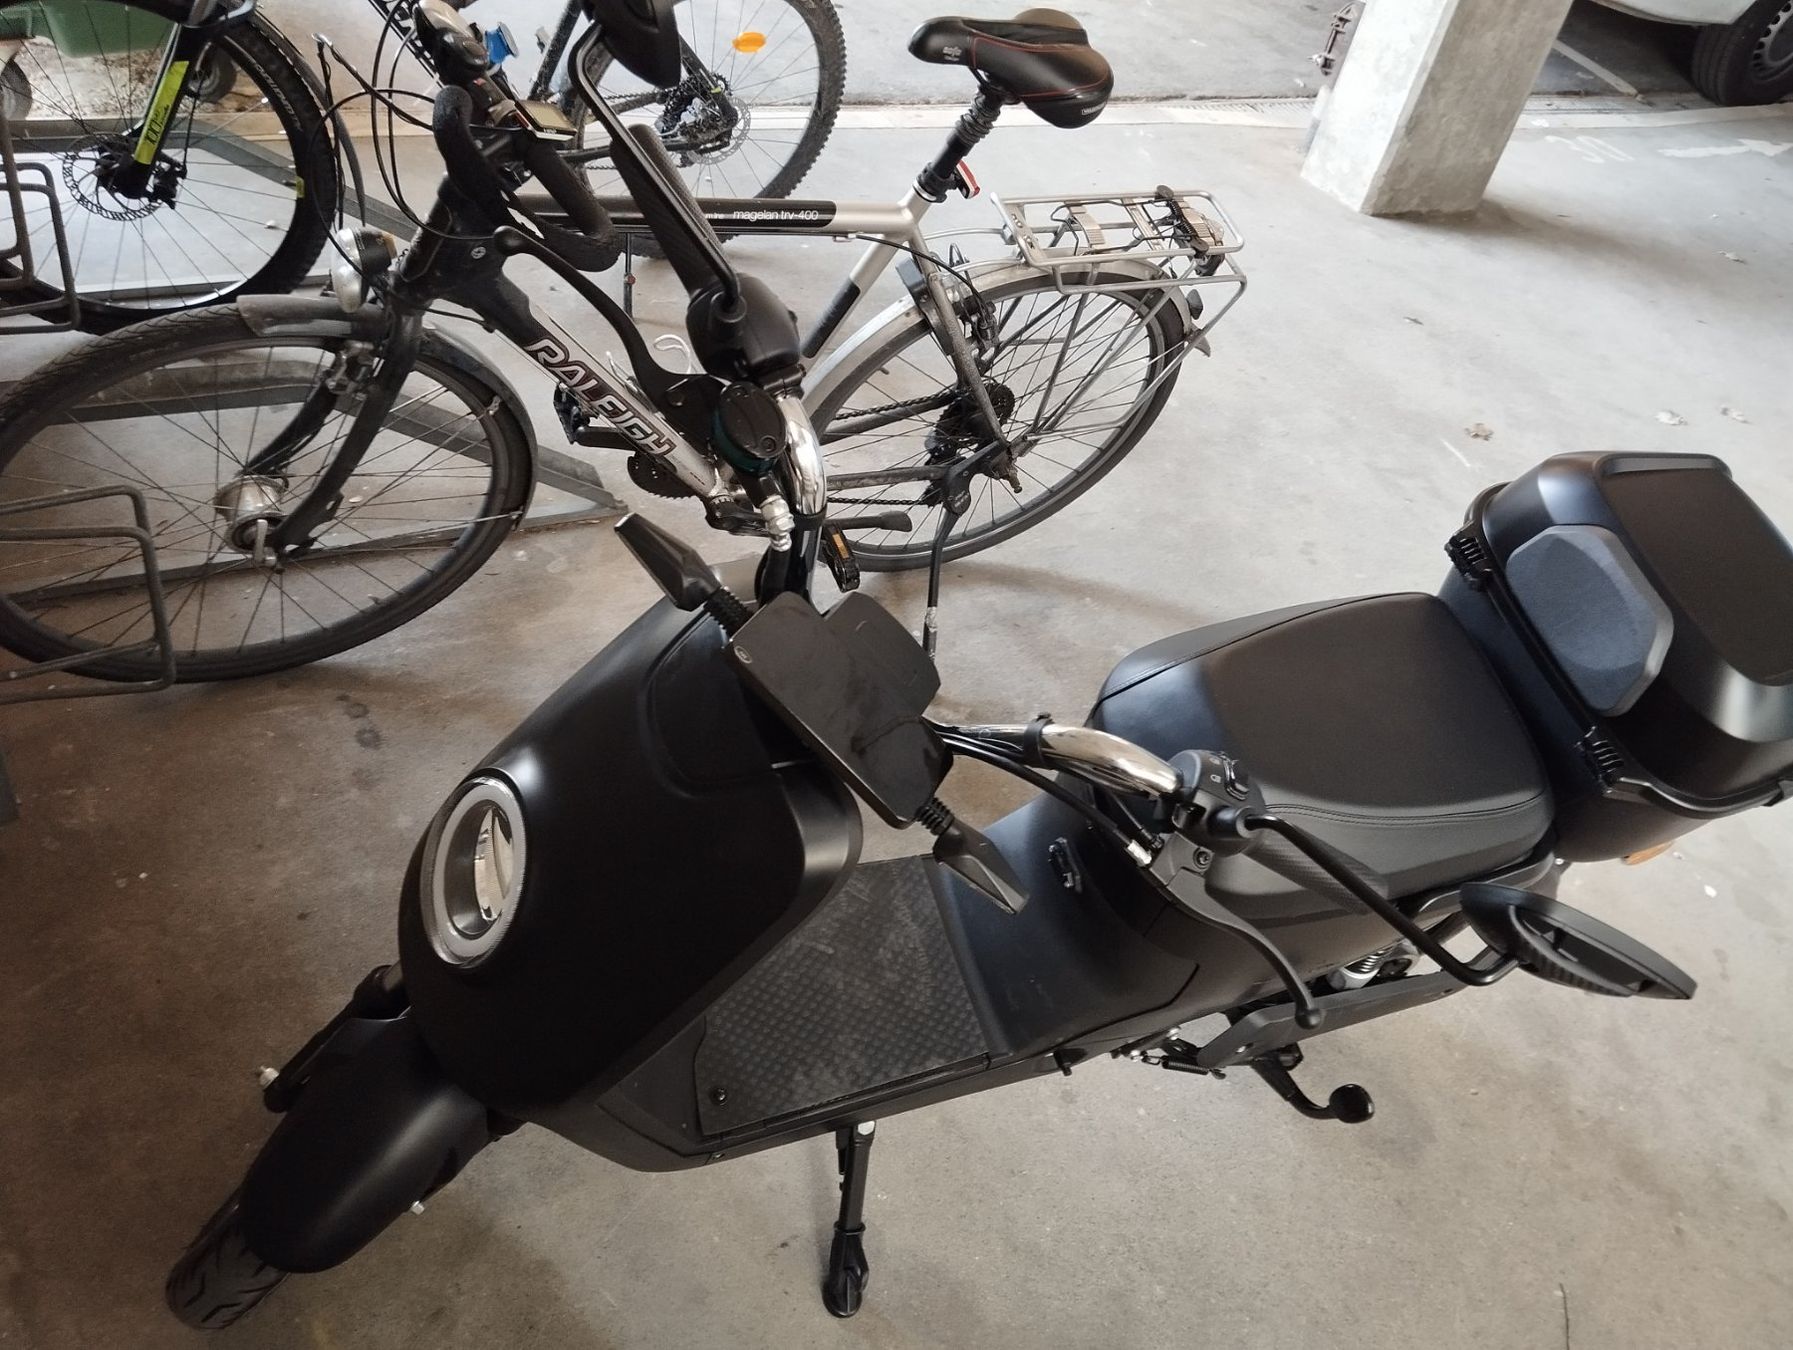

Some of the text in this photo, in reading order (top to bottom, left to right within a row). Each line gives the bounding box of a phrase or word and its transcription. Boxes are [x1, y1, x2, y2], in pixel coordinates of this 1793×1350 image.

[733, 210, 778, 222] magelan
[780, 210, 819, 220] trv-400
[525, 338, 673, 455] RALEIGH
